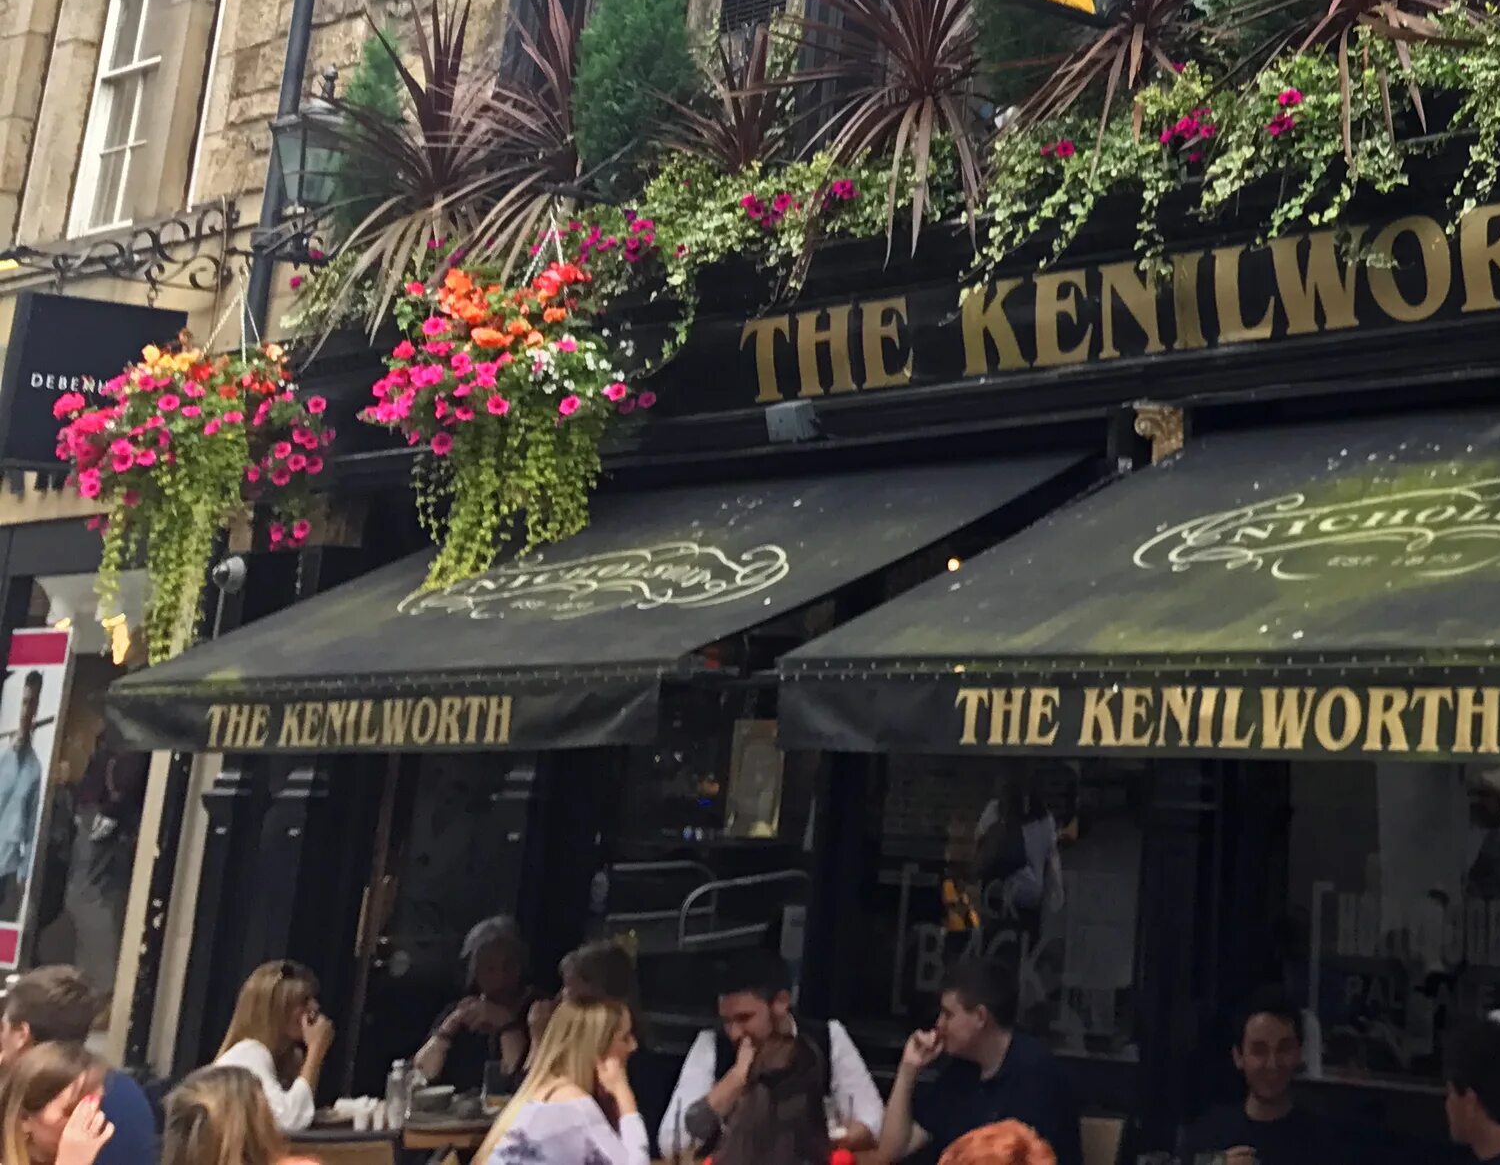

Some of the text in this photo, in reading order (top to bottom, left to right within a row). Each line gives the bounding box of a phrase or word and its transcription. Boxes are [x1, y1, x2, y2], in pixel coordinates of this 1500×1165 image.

[740, 295, 914, 404] THE
[205, 695, 512, 748] THE KENILWORTH
[955, 687, 1060, 746] THE
